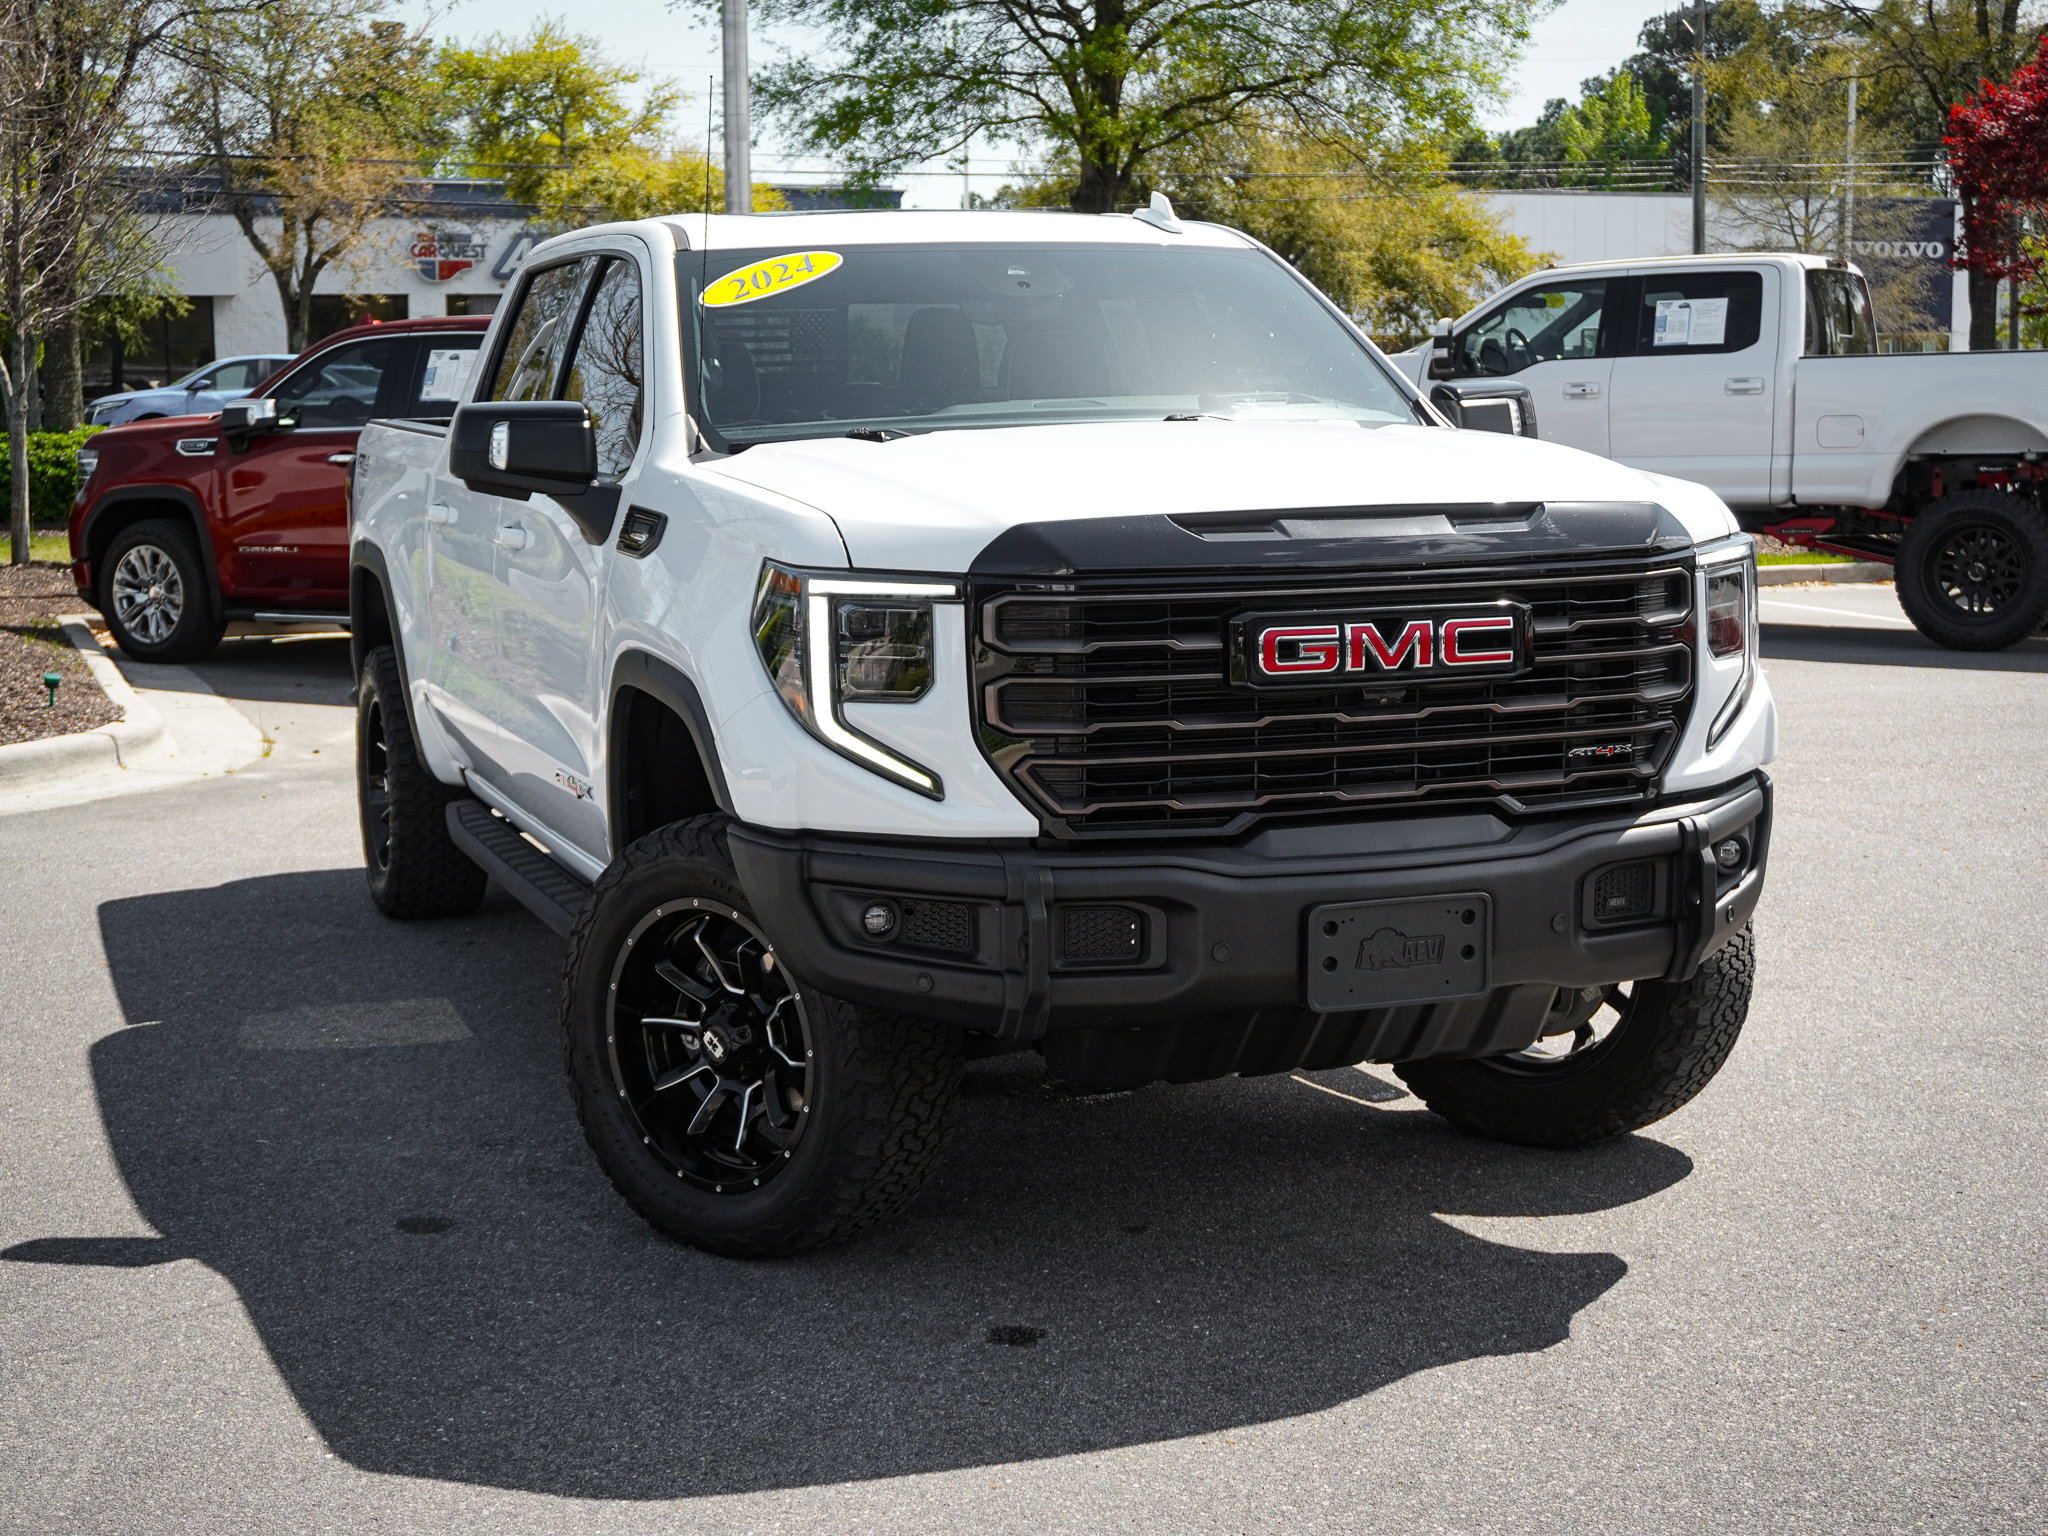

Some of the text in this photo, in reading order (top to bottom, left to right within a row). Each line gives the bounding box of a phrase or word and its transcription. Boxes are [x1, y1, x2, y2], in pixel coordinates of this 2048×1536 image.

[1853, 241, 1944, 258] VOLVO
[728, 255, 814, 300] 2024
[1259, 616, 1514, 675] GMC
[1569, 744, 1632, 757] AT4X
[1404, 939, 1441, 963] AEV
